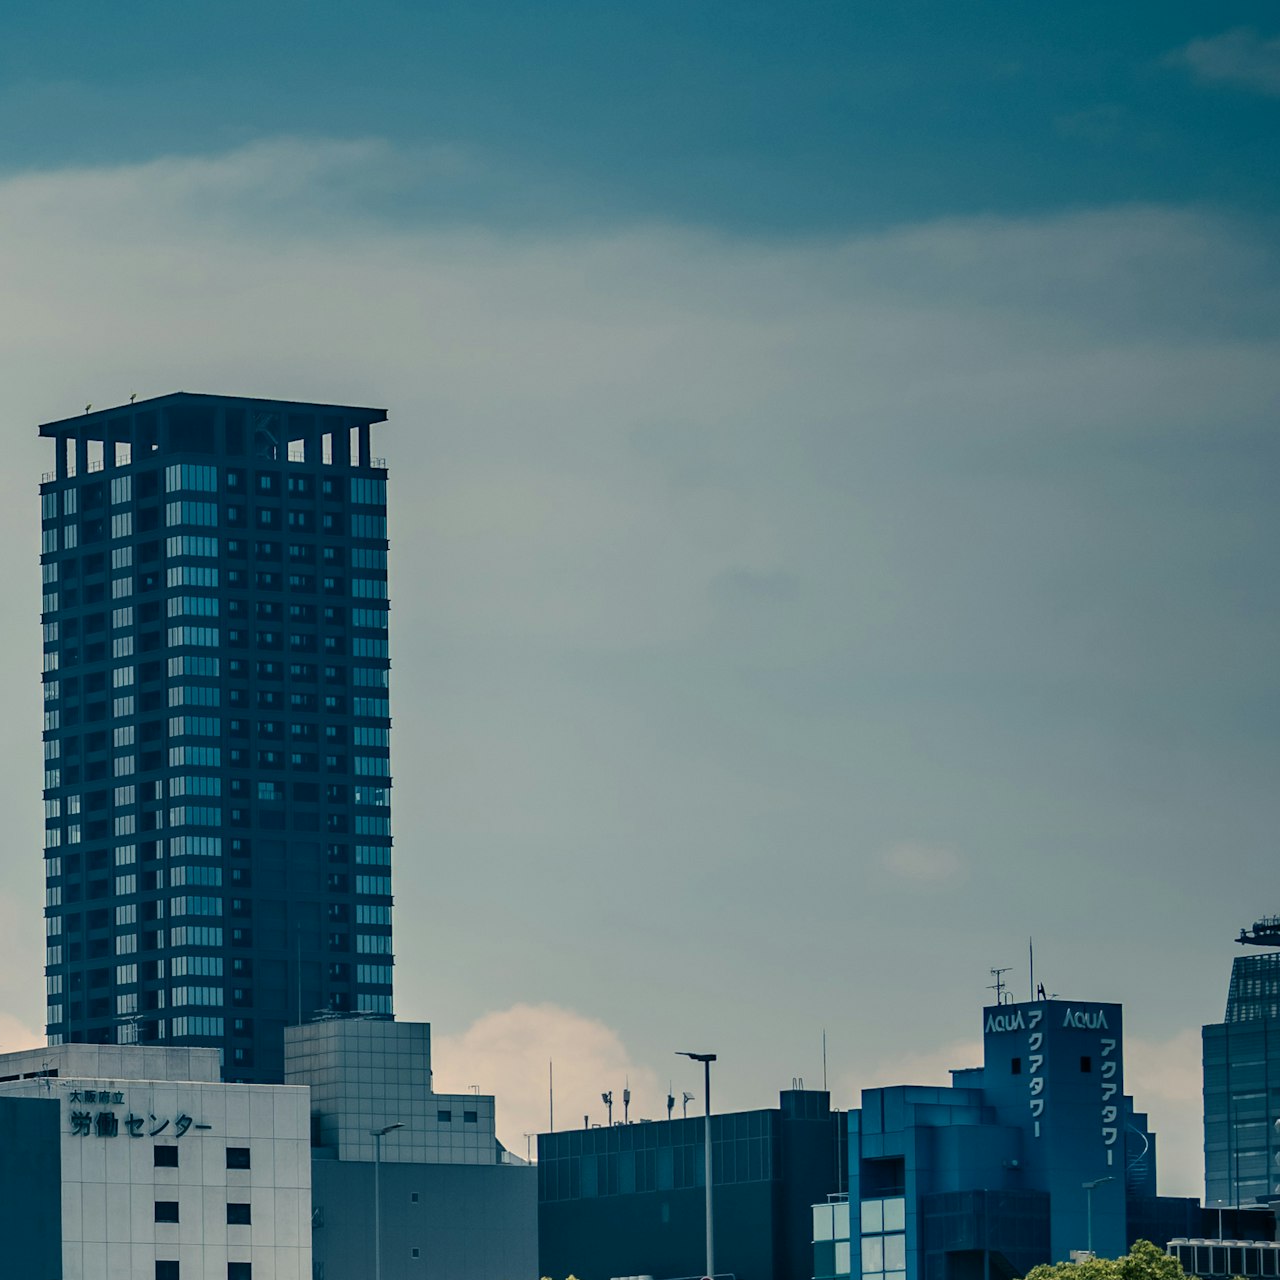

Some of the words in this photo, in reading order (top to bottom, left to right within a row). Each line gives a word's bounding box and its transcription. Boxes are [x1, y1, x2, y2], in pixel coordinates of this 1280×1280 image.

[985, 1010, 1025, 1033] AQUA
[1062, 1008, 1109, 1030] AQUA
[1028, 1010, 1044, 1138] アクアタワー
[69, 1089, 125, 1105] 大阪府立
[1100, 1038, 1118, 1166] アクアタワー
[70, 1111, 212, 1138] 労働センター
